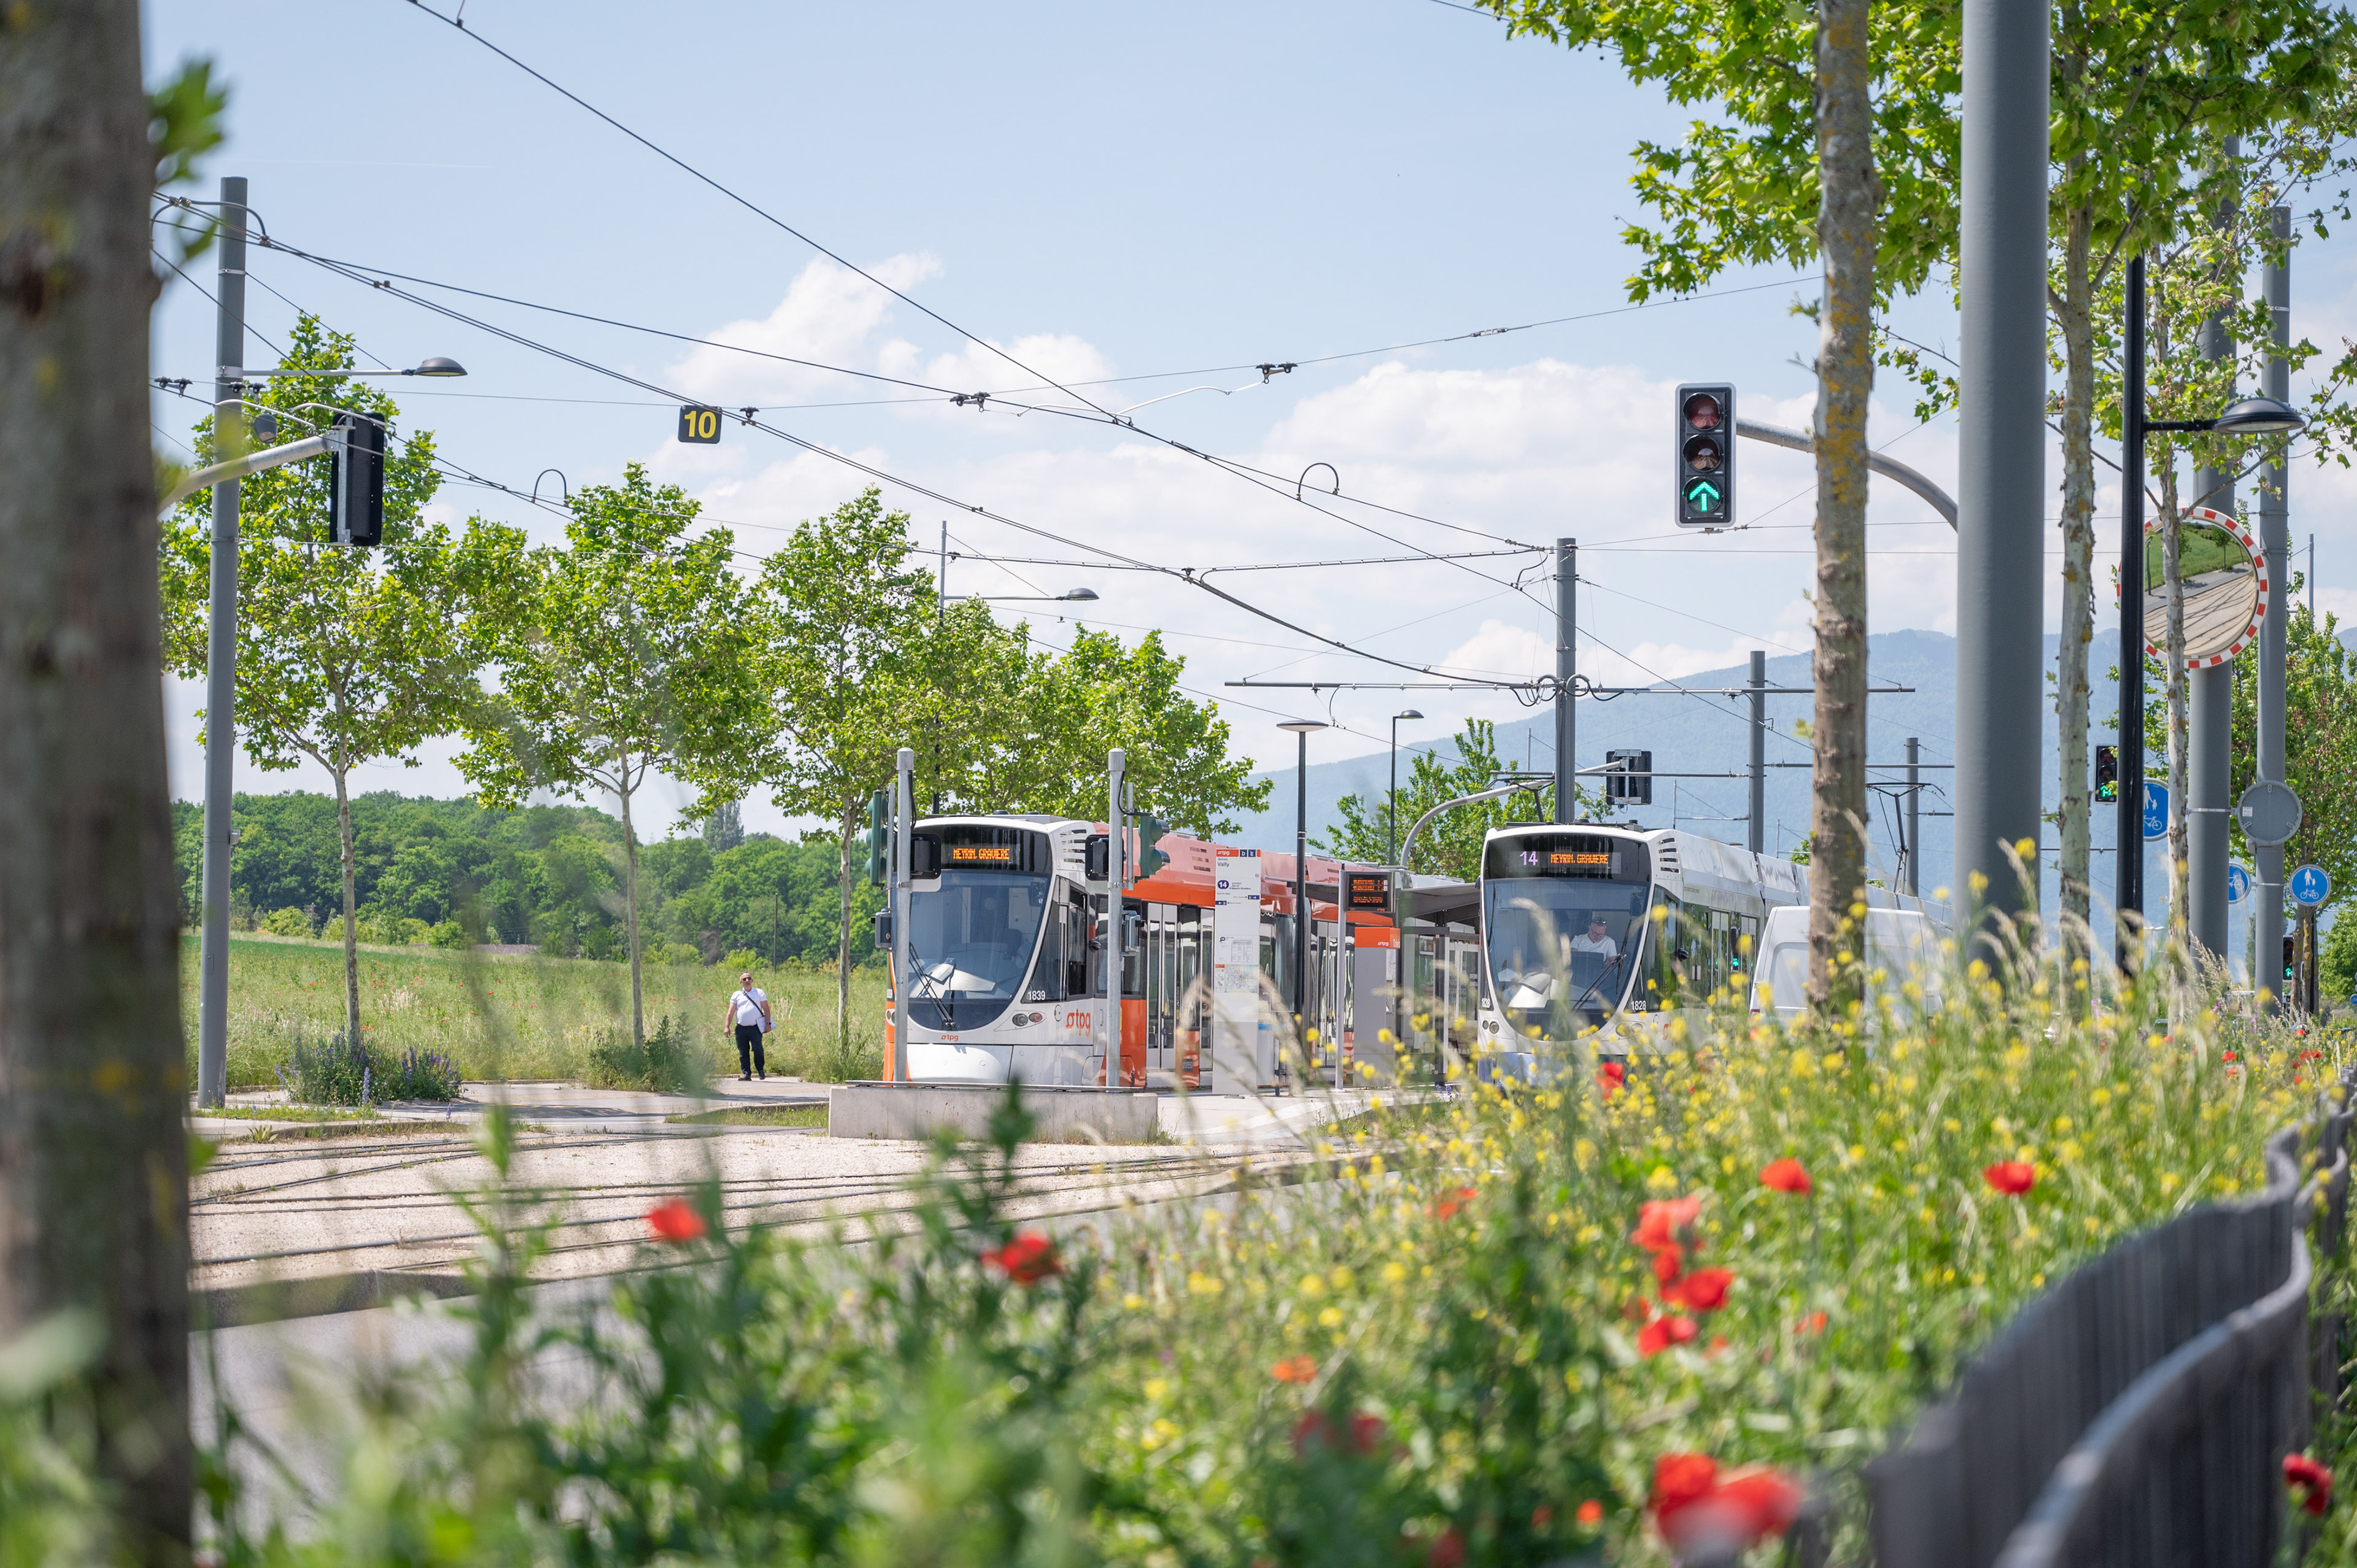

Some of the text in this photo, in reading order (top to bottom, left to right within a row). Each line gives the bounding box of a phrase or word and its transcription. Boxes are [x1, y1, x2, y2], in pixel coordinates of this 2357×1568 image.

[684, 411, 716, 438] 10
[978, 848, 1010, 860] GRAVIERE
[1520, 851, 1538, 866] 14
[1577, 854, 1609, 864] GRAVIERE
[1028, 990, 1046, 1000] 1839
[1631, 1000, 1646, 1011] 1828
